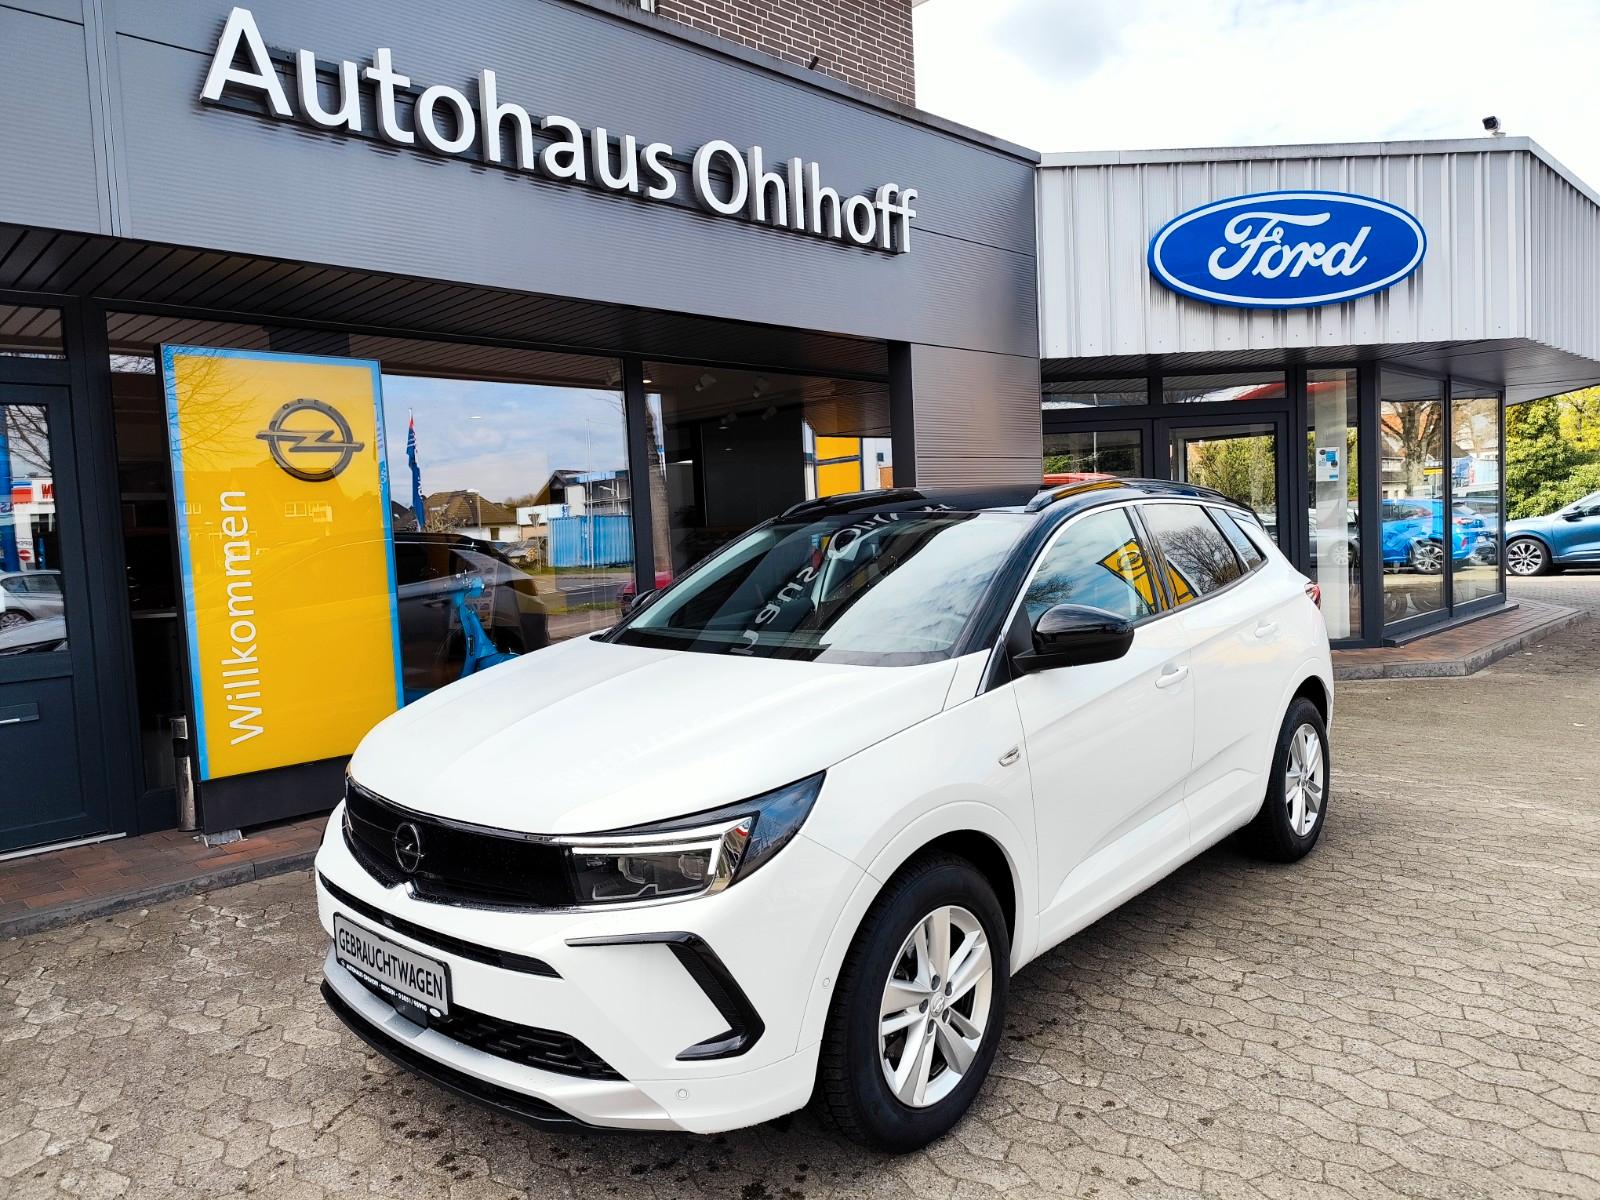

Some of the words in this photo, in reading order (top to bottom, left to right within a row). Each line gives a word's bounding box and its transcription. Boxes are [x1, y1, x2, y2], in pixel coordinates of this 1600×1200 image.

[199, 7, 677, 200] Autohaus
[692, 138, 918, 255] Ohlhoff
[1207, 211, 1372, 281] Ford
[219, 489, 265, 746] Willkommen
[338, 927, 443, 1001] GEBRAUCHTWAGEN
